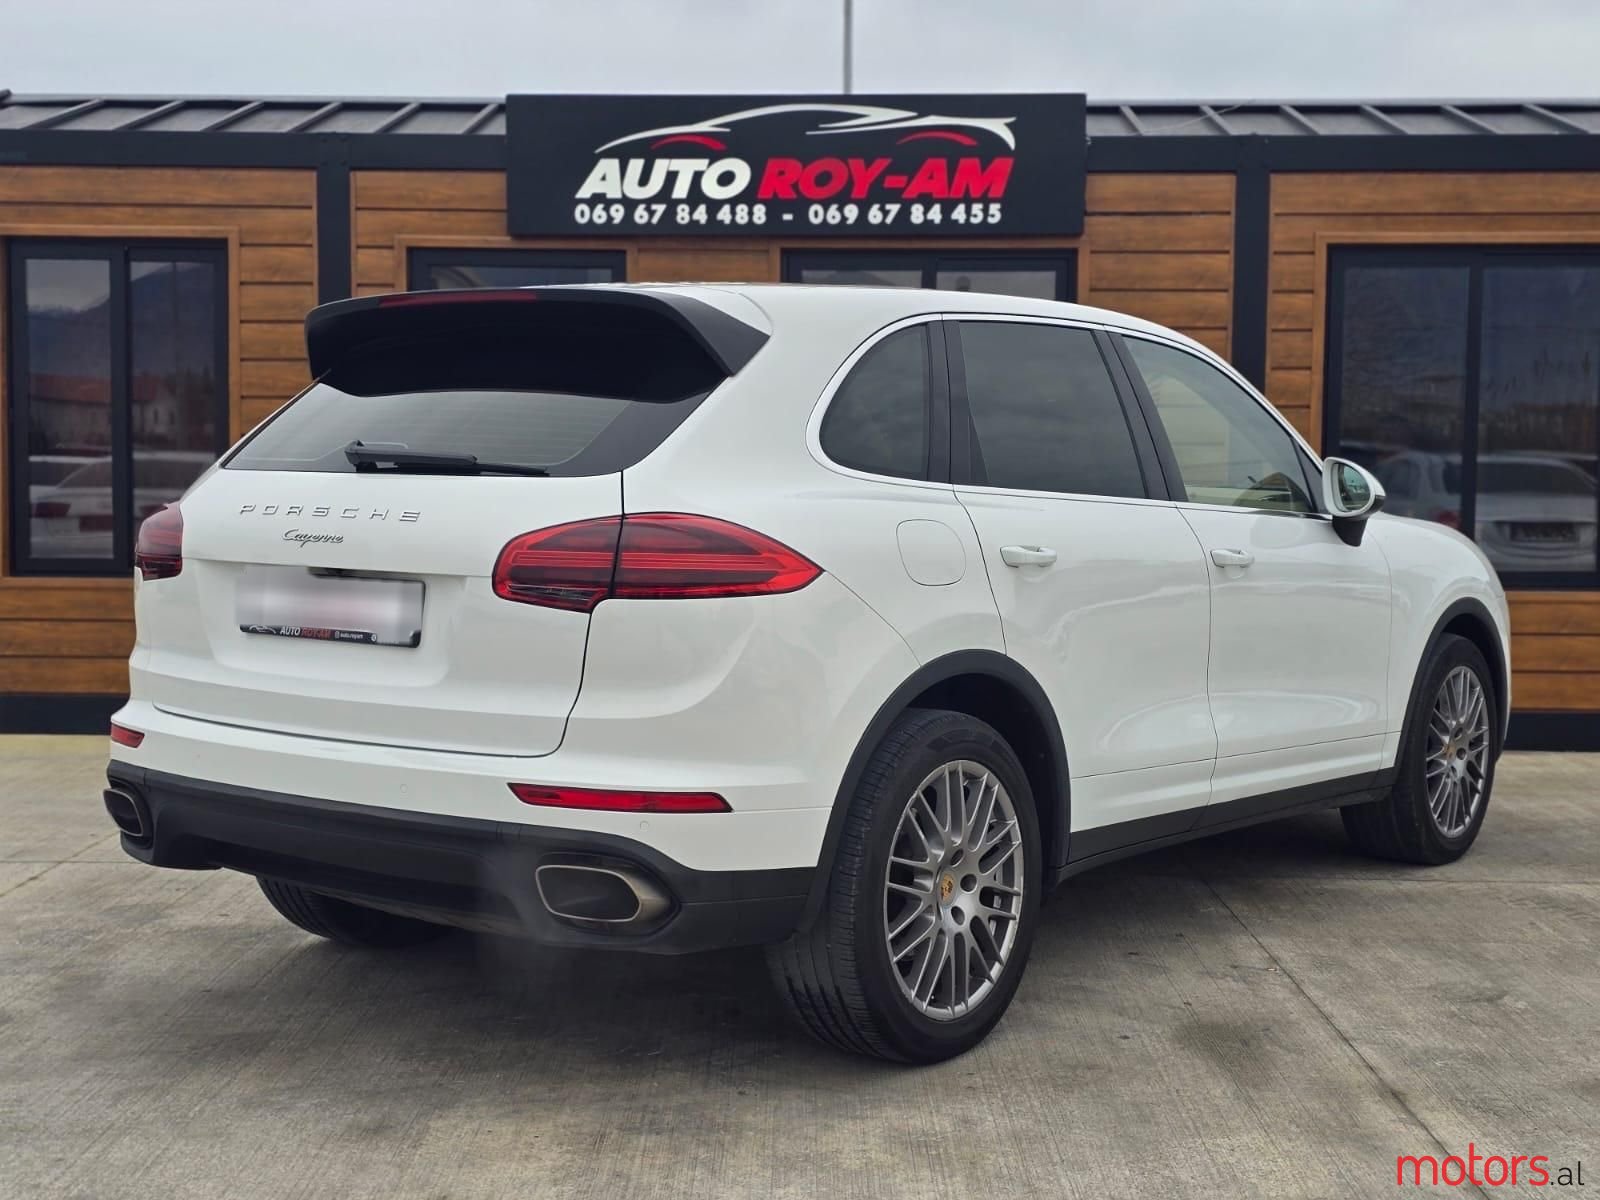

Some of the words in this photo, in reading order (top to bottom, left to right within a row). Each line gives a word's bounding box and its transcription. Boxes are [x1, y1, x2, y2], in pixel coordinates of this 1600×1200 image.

[574, 157, 752, 200] AUTO
[757, 157, 1015, 199] ROY-AM
[574, 203, 625, 224] 069
[633, 203, 667, 224] 67
[676, 203, 708, 224] 84
[716, 203, 767, 224] 488
[808, 203, 859, 225] 069
[868, 203, 902, 225] 67
[910, 203, 943, 224] 84
[951, 203, 1002, 224] 455
[239, 504, 421, 522] PORSCHE
[282, 529, 344, 548] Cayenne
[280, 626, 301, 636] AUTO
